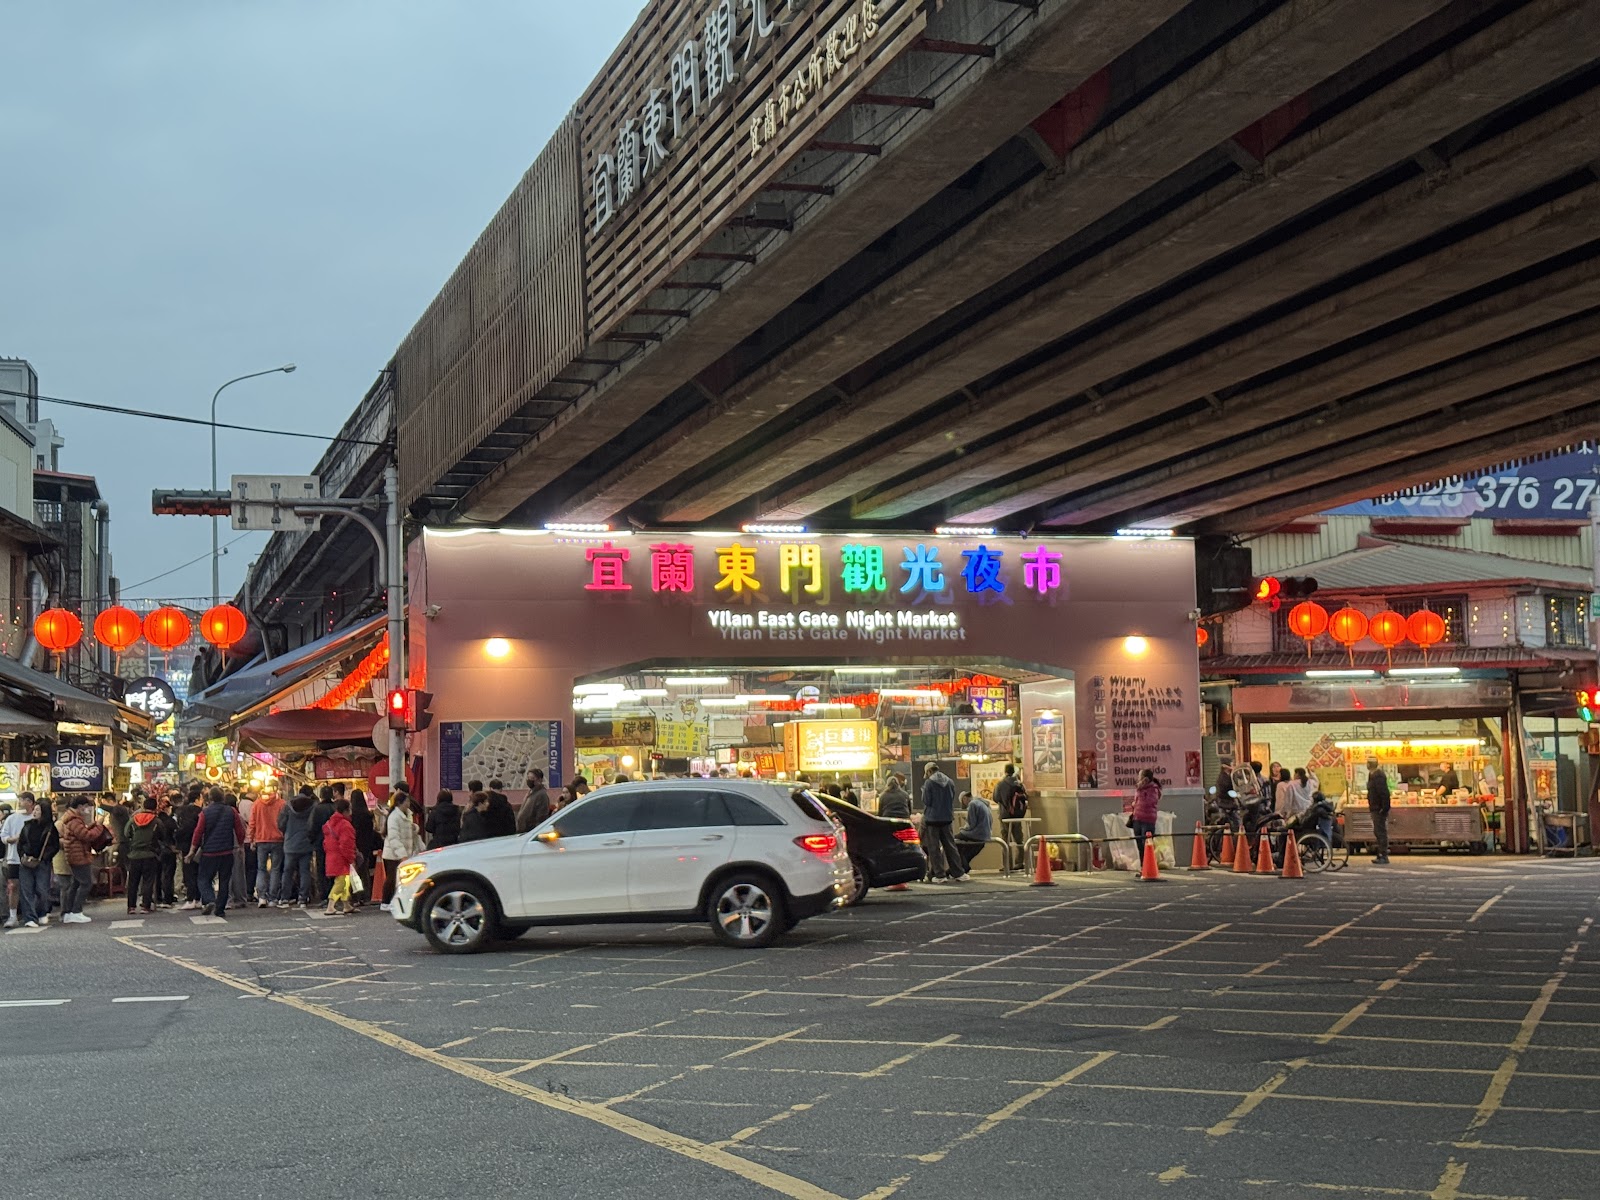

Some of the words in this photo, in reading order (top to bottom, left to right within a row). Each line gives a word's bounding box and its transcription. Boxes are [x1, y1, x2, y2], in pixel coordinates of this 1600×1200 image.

[750, 0, 879, 158] 宜蘭市公所歡迎您
[593, 0, 804, 234] 宜蘭東門觀光
[1475, 475, 1540, 509] 376
[1552, 478, 1600, 511] 27
[583, 541, 1064, 594] 宜蘭東門觀光夜市
[708, 611, 753, 628] Yilan
[758, 611, 795, 628] East
[798, 611, 839, 628] Gate
[846, 611, 893, 631] Night
[897, 611, 957, 628] Market
[1110, 675, 1146, 688] Witamy
[1112, 698, 1148, 708] Selamat
[1150, 698, 1182, 709] Datang
[550, 721, 558, 747] Yilan
[1112, 720, 1150, 729] Welkom
[1095, 705, 1108, 787] WELCOME
[1113, 743, 1171, 752] Boas-vindas
[56, 748, 95, 766] 日船
[549, 750, 558, 770] City
[1114, 755, 1158, 763] Bienvenu
[1114, 766, 1167, 775] Bienvido
[1115, 777, 1172, 786] Willken
